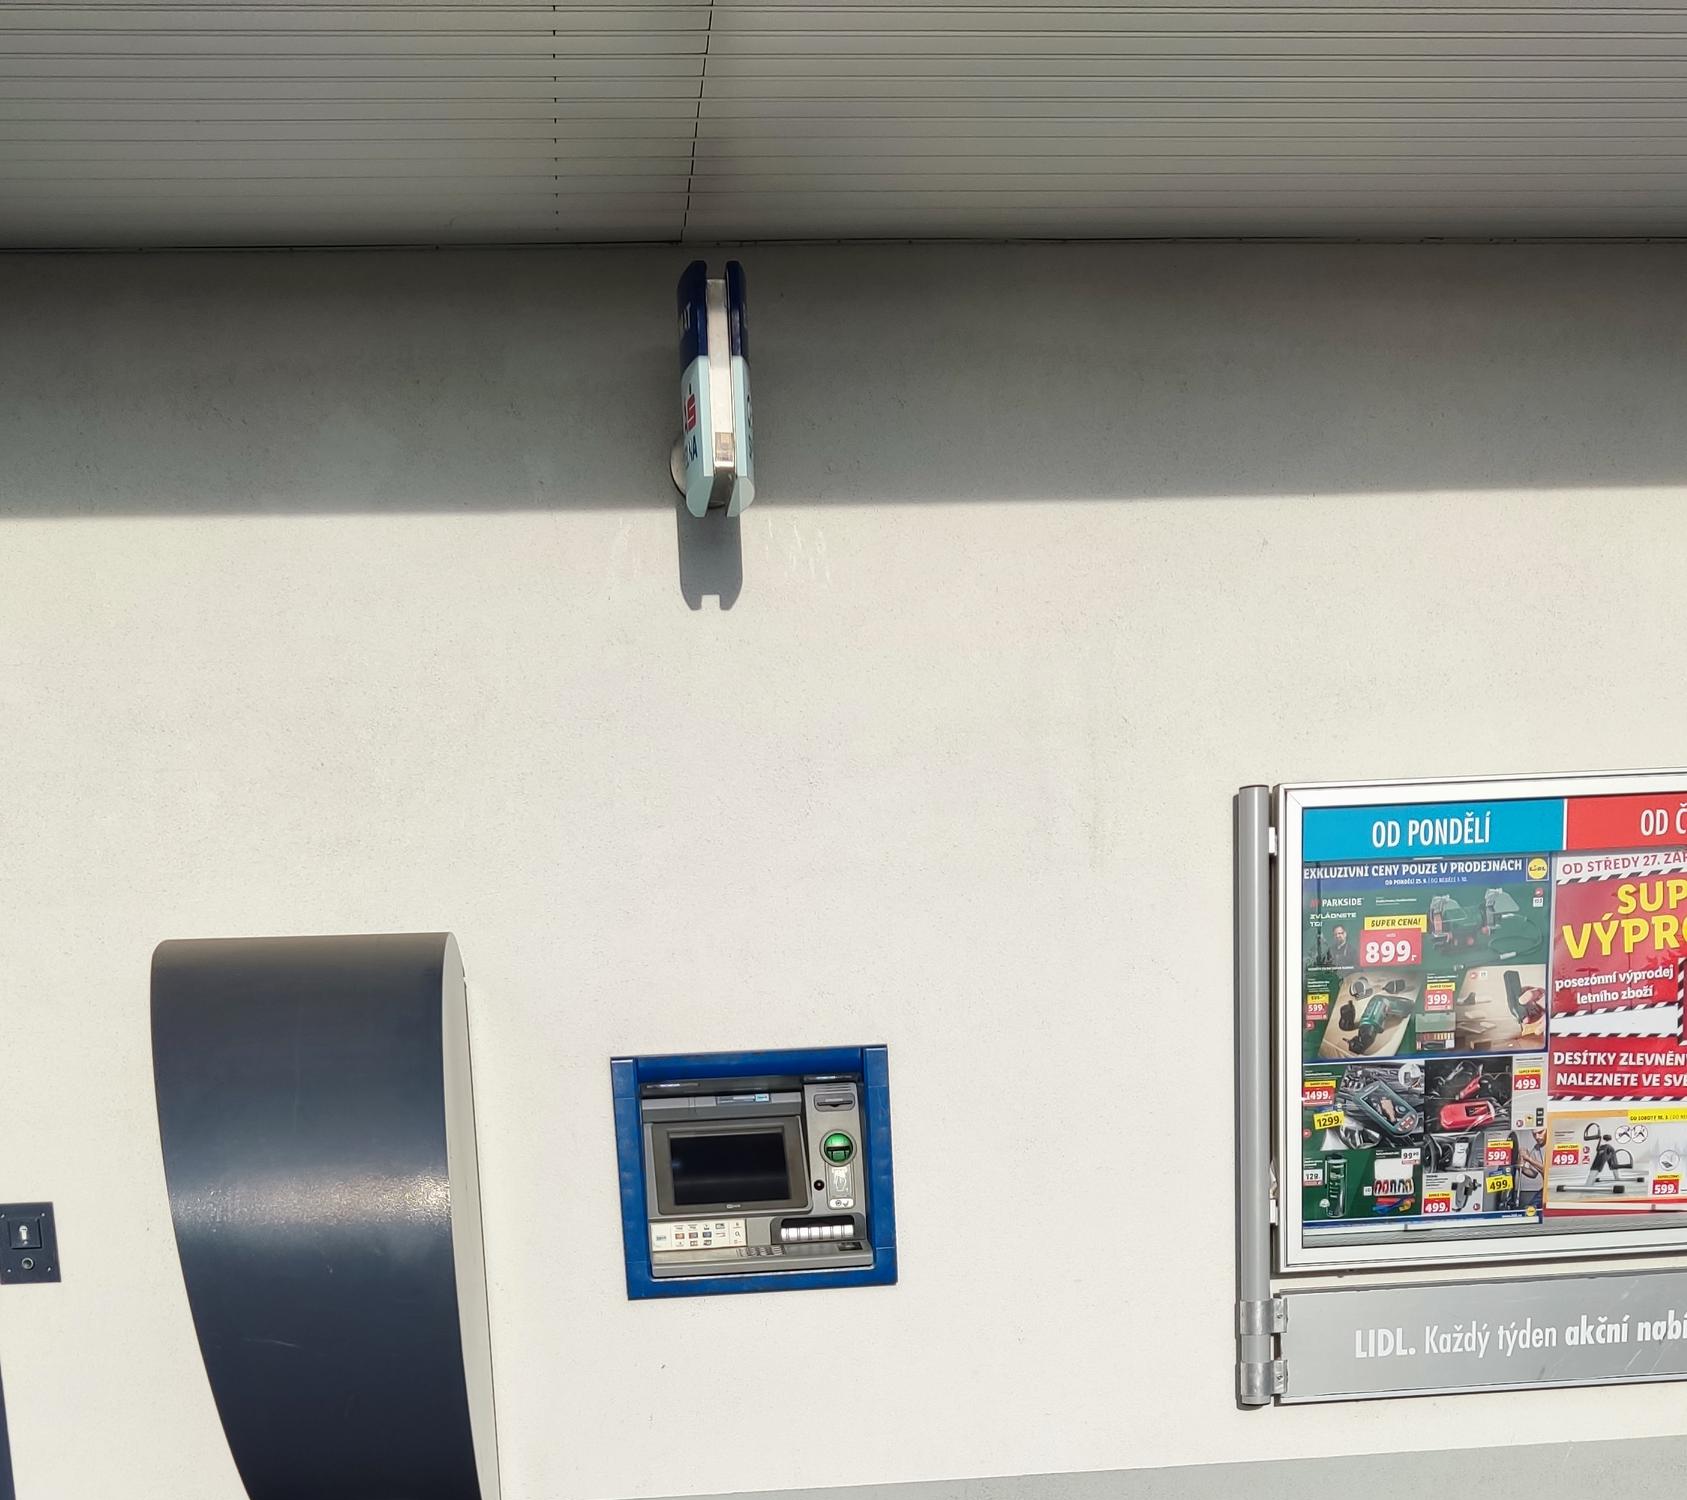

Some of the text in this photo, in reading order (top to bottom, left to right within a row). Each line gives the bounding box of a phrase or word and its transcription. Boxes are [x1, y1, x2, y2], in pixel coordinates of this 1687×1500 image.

[1372, 811, 1491, 848] OD PONDĚLÍ
[1641, 809, 1669, 836] OD
[1303, 859, 1522, 879] EXKLUZIVNÍ CENY POUZE V PRODEJNÁCH
[1562, 862, 1583, 875] OD
[1587, 856, 1640, 873] STŘEDY
[1643, 854, 1660, 866] 27.
[1322, 898, 1362, 907] PARKSIDE
[1371, 918, 1421, 928] SUPER CENA!
[1561, 912, 1687, 959] VÝPR
[1555, 964, 1674, 992] posezónní výprodej
[1577, 985, 1654, 1005] letního zboží
[1553, 1050, 1616, 1065] DESÍTKY
[1619, 1050, 1687, 1066] ZLEVNĚN
[1556, 1073, 1638, 1086] NALEZNETE
[1642, 1073, 1660, 1087] VE
[1355, 1326, 1416, 1358] LIDL.
[1425, 1320, 1490, 1358] Každý
[1498, 1317, 1557, 1357] týden
[1565, 1314, 1630, 1346] akční
